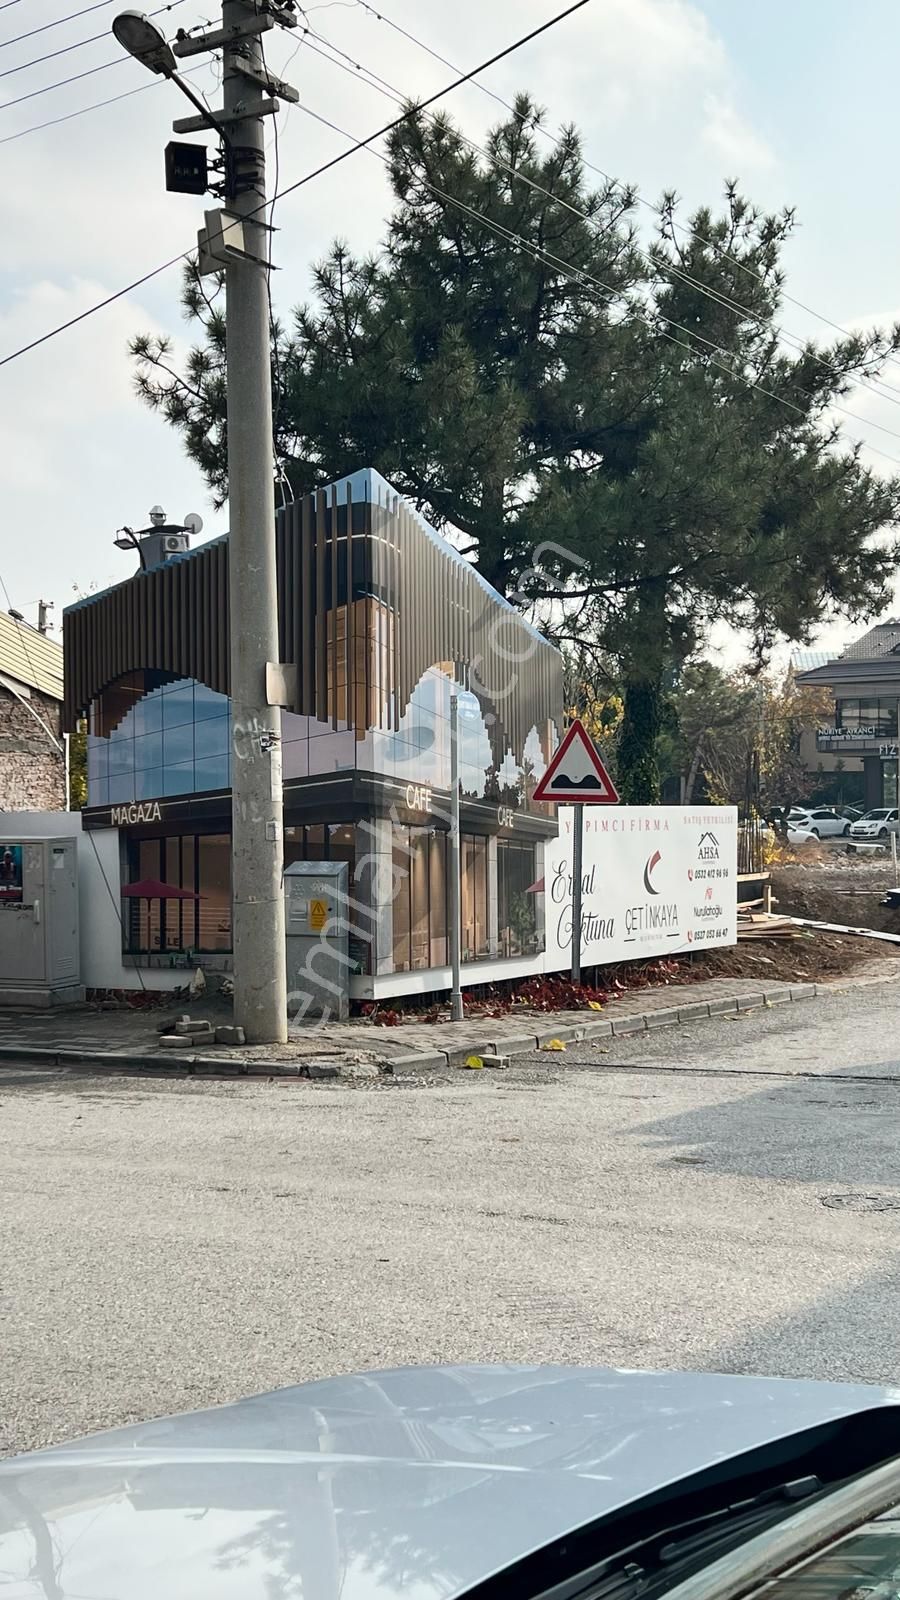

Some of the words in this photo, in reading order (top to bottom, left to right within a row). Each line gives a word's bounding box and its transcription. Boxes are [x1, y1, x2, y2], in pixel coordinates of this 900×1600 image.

[405, 784, 432, 813] CAFE
[111, 799, 162, 826] MAĞAZA
[497, 806, 514, 828] CAFE
[565, 819, 625, 833] YPIMCI
[697, 846, 720, 860] AHSA
[551, 859, 596, 903] Eral
[625, 903, 679, 935] ÇETİNKAYA
[154, 935, 180, 946] SLE
